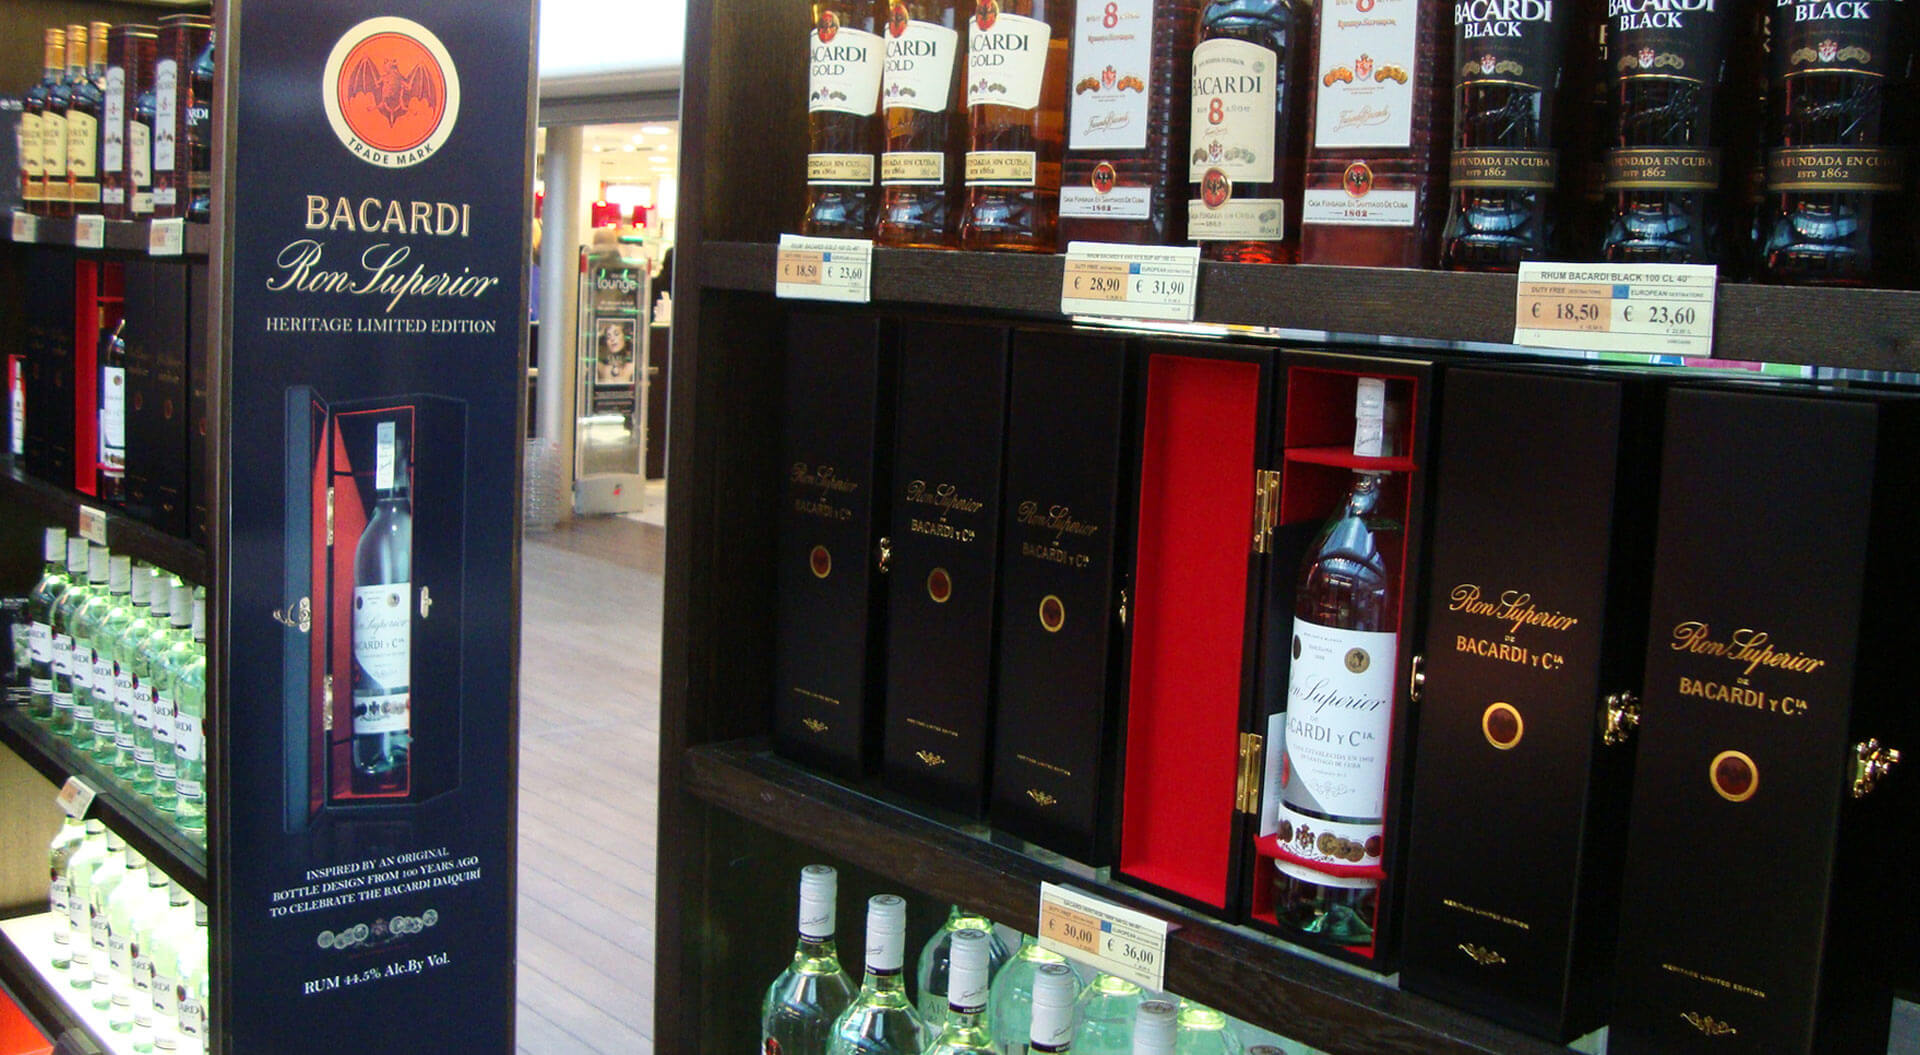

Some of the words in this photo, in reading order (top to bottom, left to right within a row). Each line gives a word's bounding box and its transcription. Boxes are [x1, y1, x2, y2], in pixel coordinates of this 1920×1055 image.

[1103, 2, 1118, 28] 8
[1454, 0, 1553, 25] BACARDI
[1620, 12, 1683, 31] BLACK
[1795, 2, 1871, 22] BLACK
[1464, 21, 1522, 39] BLACK
[1208, 97, 1224, 125] 8
[349, 137, 389, 165] TRADE
[396, 143, 434, 165] MARK
[1504, 157, 1519, 166] EN
[1521, 157, 1550, 167] CUBA
[1664, 157, 1679, 166] EN
[1682, 156, 1712, 166] CUBA
[1846, 156, 1863, 166] EN
[1484, 167, 1507, 177] 1862
[1642, 167, 1666, 177] 1862
[1821, 167, 1849, 178] 1862
[305, 195, 471, 237] BACARDI
[266, 239, 350, 292] Ron
[350, 243, 499, 313] Superior
[840, 267, 862, 280] 23,60
[1541, 271, 1566, 280] RHUM
[1568, 272, 1609, 281] BACARDI
[1611, 273, 1642, 282] BLACK
[1645, 274, 1660, 282] 100
[1662, 274, 1674, 282] CL
[1074, 276, 1081, 290] €
[1090, 277, 1120, 292] 28,90
[1136, 279, 1143, 293] €
[1152, 280, 1184, 295] 31,90
[1630, 289, 1668, 297] EUROPEAN
[266, 317, 352, 332] HERITAGE
[357, 318, 427, 333] LIMITED
[431, 319, 496, 333] EDITION
[1532, 302, 1541, 318] €
[1556, 303, 1599, 322] 18,50
[1624, 306, 1633, 322] €
[1650, 306, 1695, 325] 23,60
[912, 519, 953, 538] BACARDI
[1449, 584, 1498, 616] Ron
[1497, 590, 1578, 633] Superior
[1456, 635, 1527, 664] BACARDI
[1531, 655, 1539, 667] Y
[1671, 621, 1727, 656] Ron
[1727, 628, 1825, 675] Superior
[1304, 674, 1386, 714] Superior
[1679, 676, 1764, 709] BACARDI
[1769, 699, 1779, 712] Y
[1337, 734, 1344, 745] Y
[306, 862, 360, 881] INSPIRED
[361, 859, 377, 871] BY
[379, 856, 395, 868] AN
[397, 847, 450, 864] ORIGINAL
[272, 884, 320, 902] BOTTLE
[322, 876, 366, 893] DESIGN
[367, 870, 400, 885] FROM
[402, 868, 419, 879] 100
[421, 860, 455, 876] YEARS
[456, 855, 479, 868] AGO
[269, 905, 288, 918] TO
[289, 893, 356, 914] CELEBRATE
[357, 888, 382, 901] THE
[383, 879, 431, 897] BACARDI
[1049, 918, 1056, 931] €
[1064, 923, 1093, 945] 30,00
[1107, 938, 1115, 951] €
[1123, 943, 1154, 965] 36,00
[304, 975, 340, 994] RUM
[343, 967, 382, 986] 44.5%
[384, 958, 424, 978] Alc.By
[426, 952, 451, 969] Vol.
